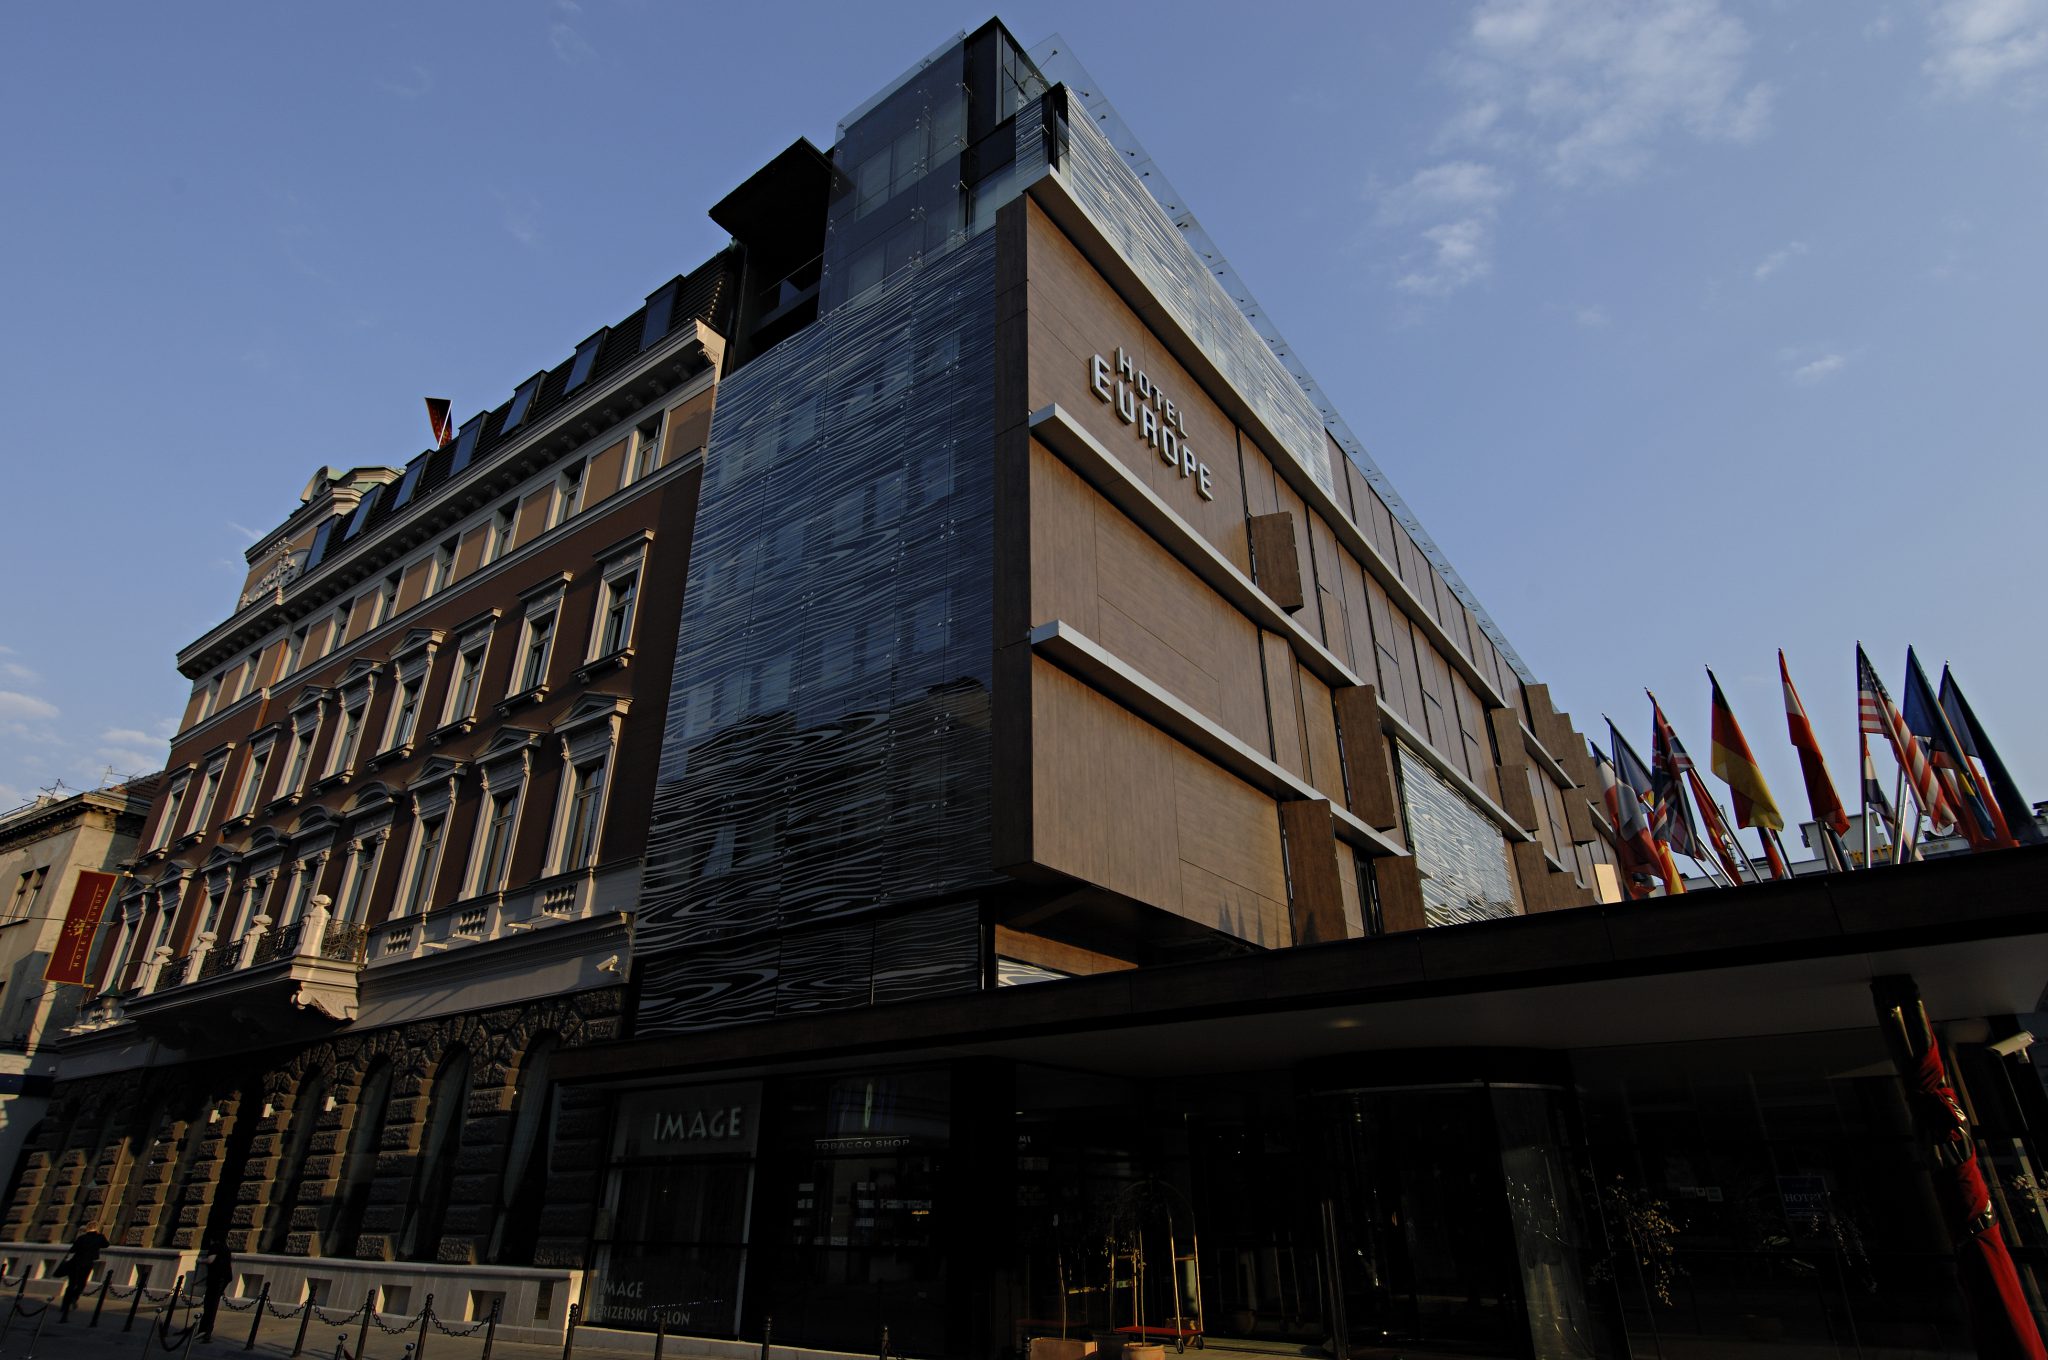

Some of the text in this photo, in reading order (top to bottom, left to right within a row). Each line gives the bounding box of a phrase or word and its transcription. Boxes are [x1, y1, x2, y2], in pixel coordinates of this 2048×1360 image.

[1114, 346, 1189, 440] HOTEL
[1089, 353, 1214, 502] EUROPE
[72, 932, 89, 968] HOTEL
[653, 1106, 742, 1140] IMAGE
[815, 1138, 911, 1151] TOBACCO SHOP
[601, 1279, 644, 1299] IMAGE
